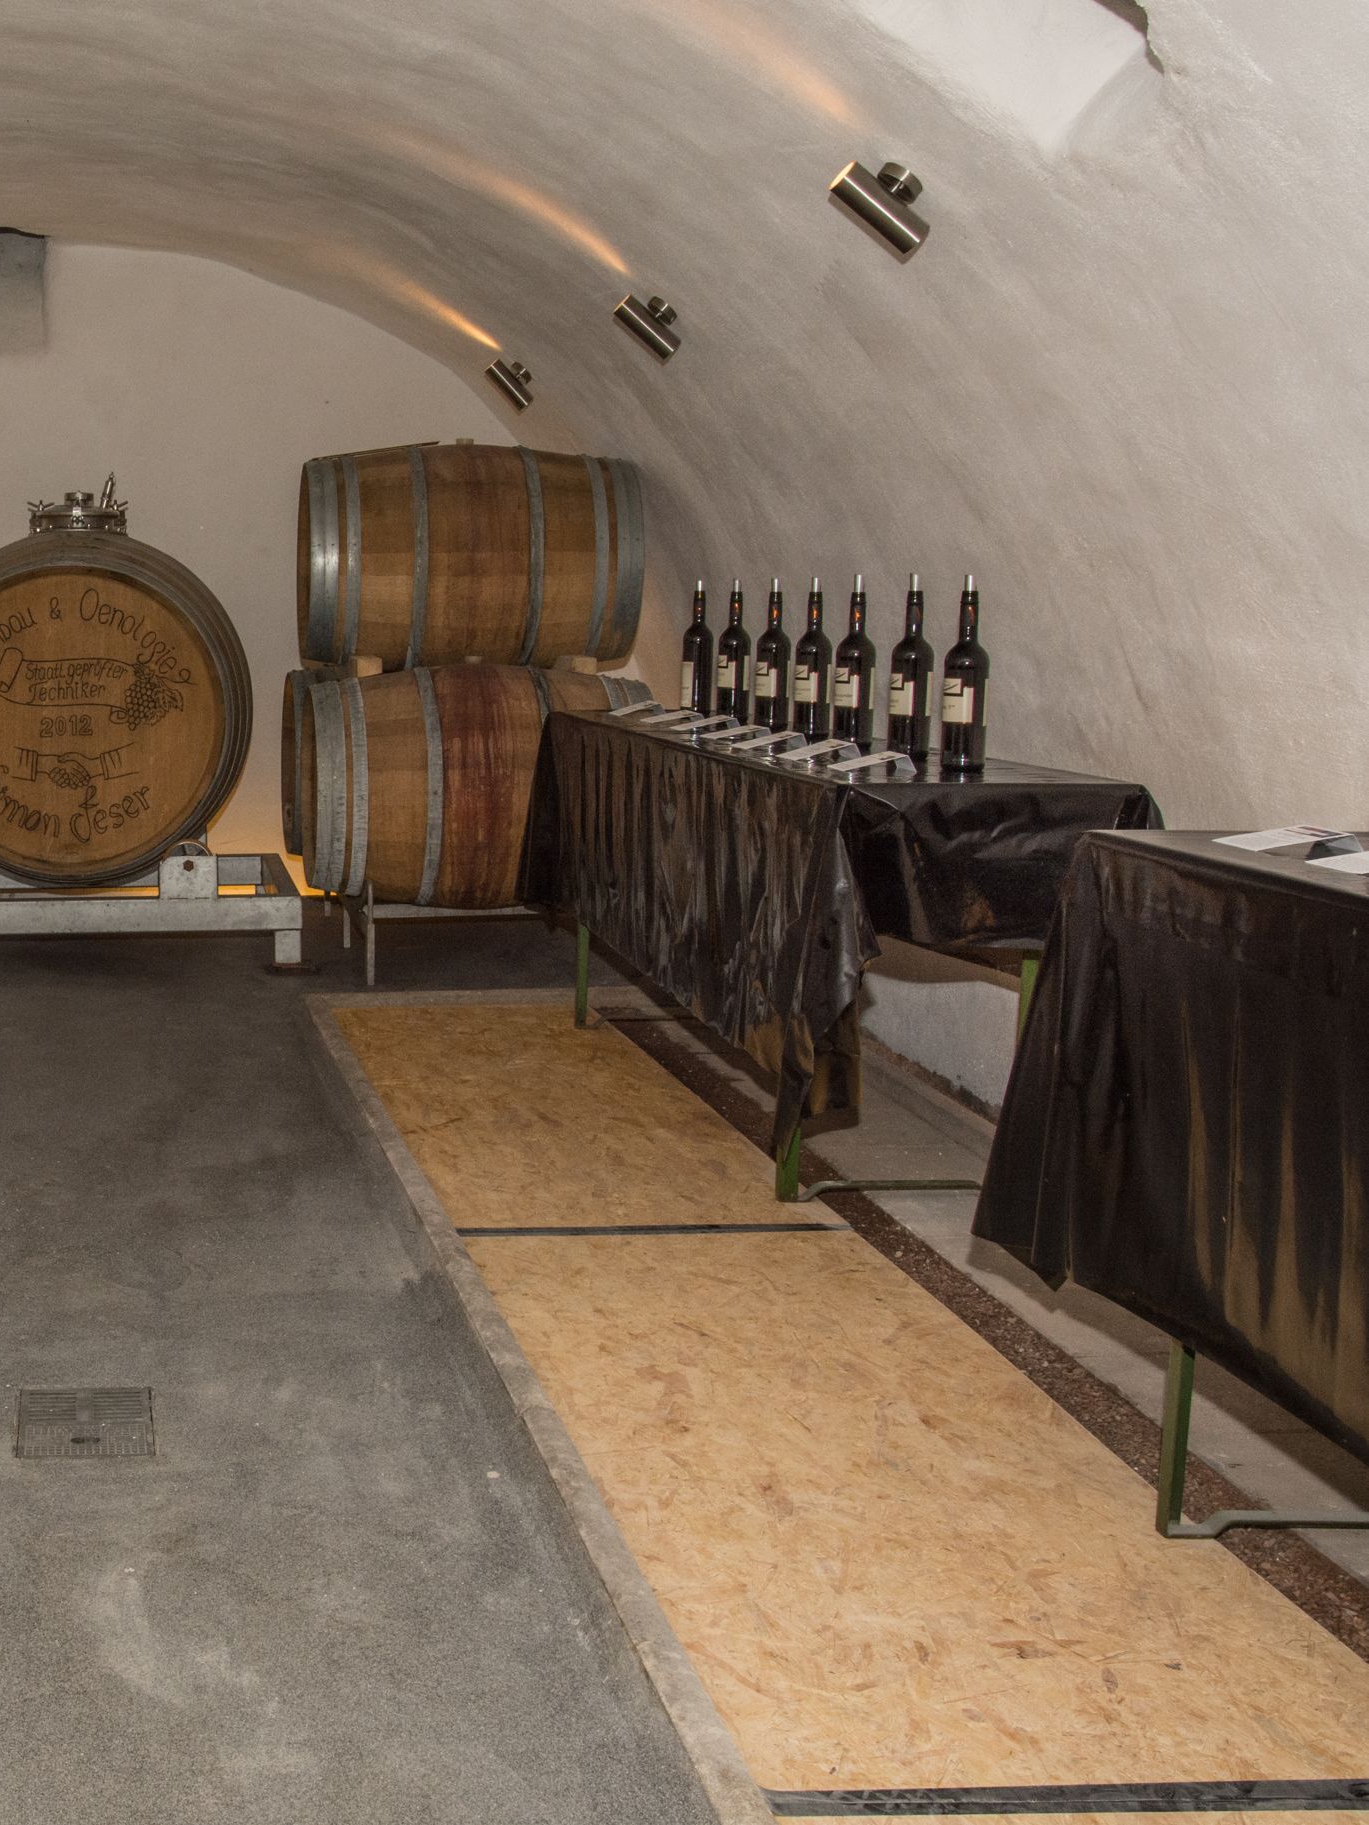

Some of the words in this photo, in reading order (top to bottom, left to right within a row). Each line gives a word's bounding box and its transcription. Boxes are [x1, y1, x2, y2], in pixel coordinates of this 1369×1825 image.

[49, 596, 62, 620] &
[80, 588, 179, 674] Oenologie
[26, 680, 106, 705] Techniker
[40, 714, 93, 738] 2012
